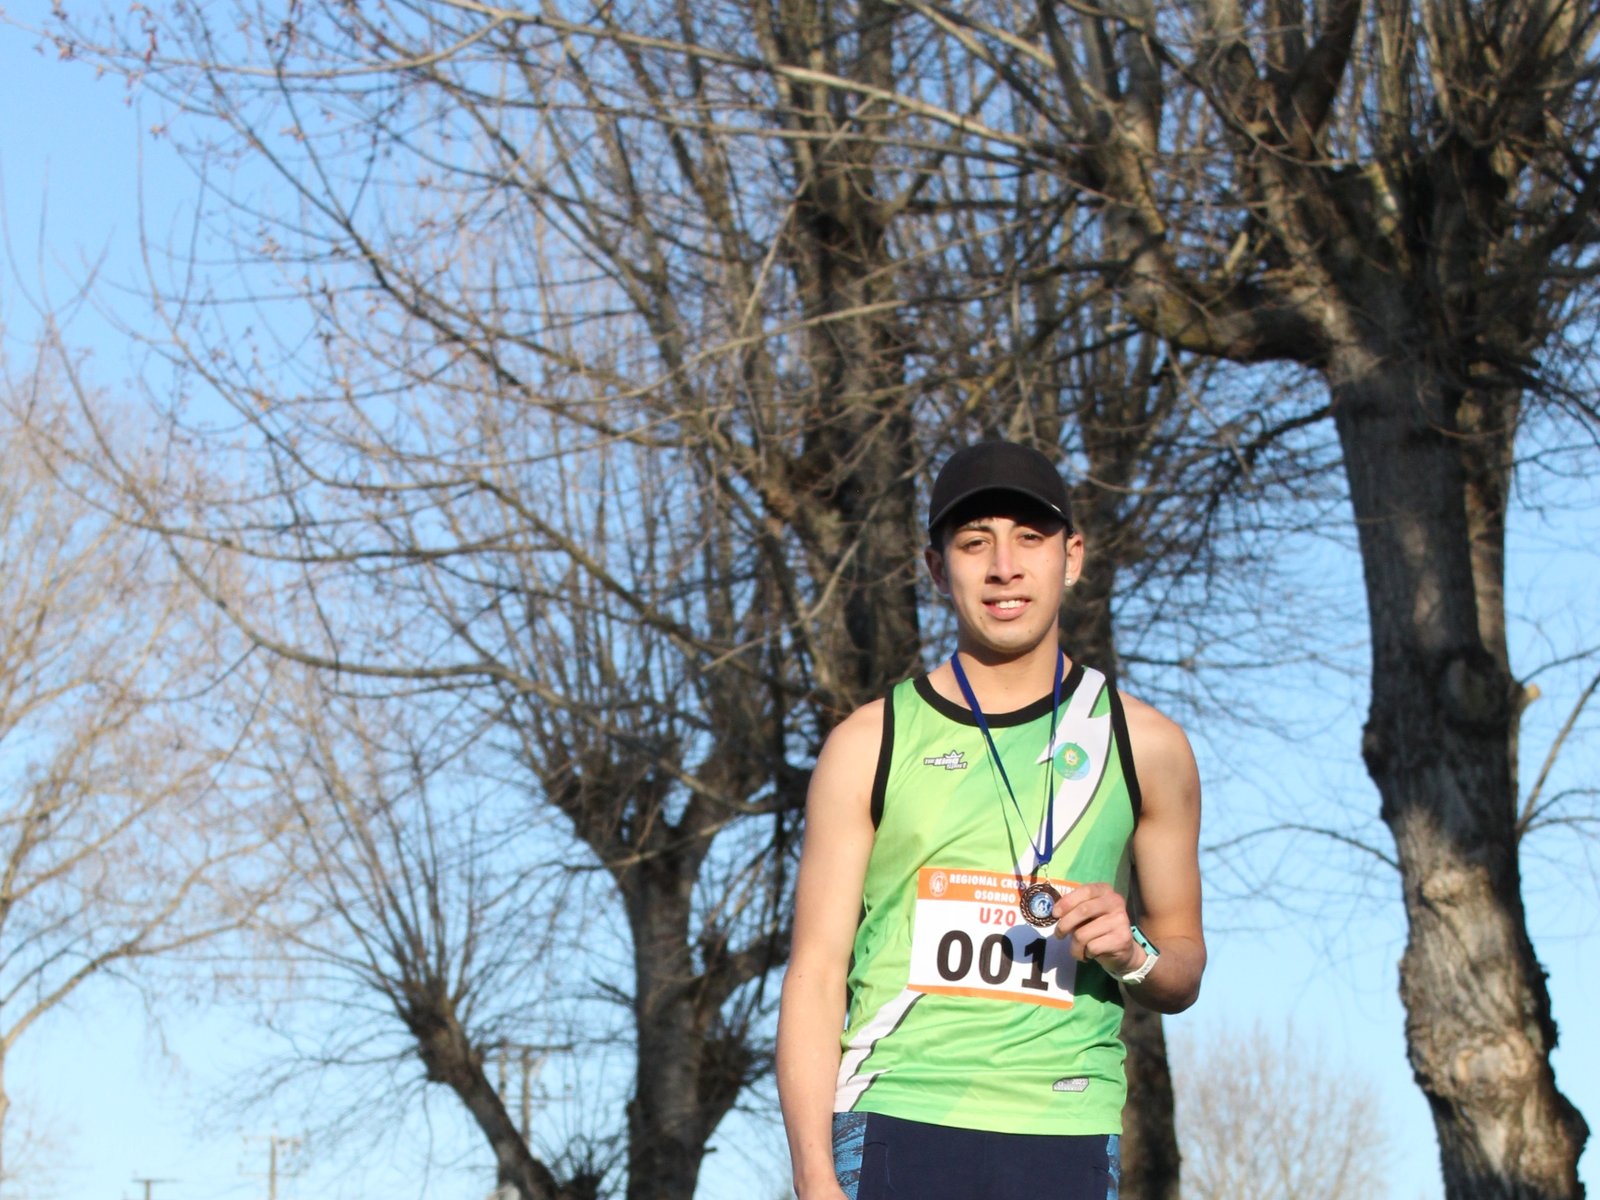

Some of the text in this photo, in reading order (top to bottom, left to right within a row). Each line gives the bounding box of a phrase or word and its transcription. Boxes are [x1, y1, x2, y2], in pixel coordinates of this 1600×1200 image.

[949, 874, 998, 887] REGIONAL
[979, 907, 1017, 927] U20
[936, 930, 1050, 991] 001
